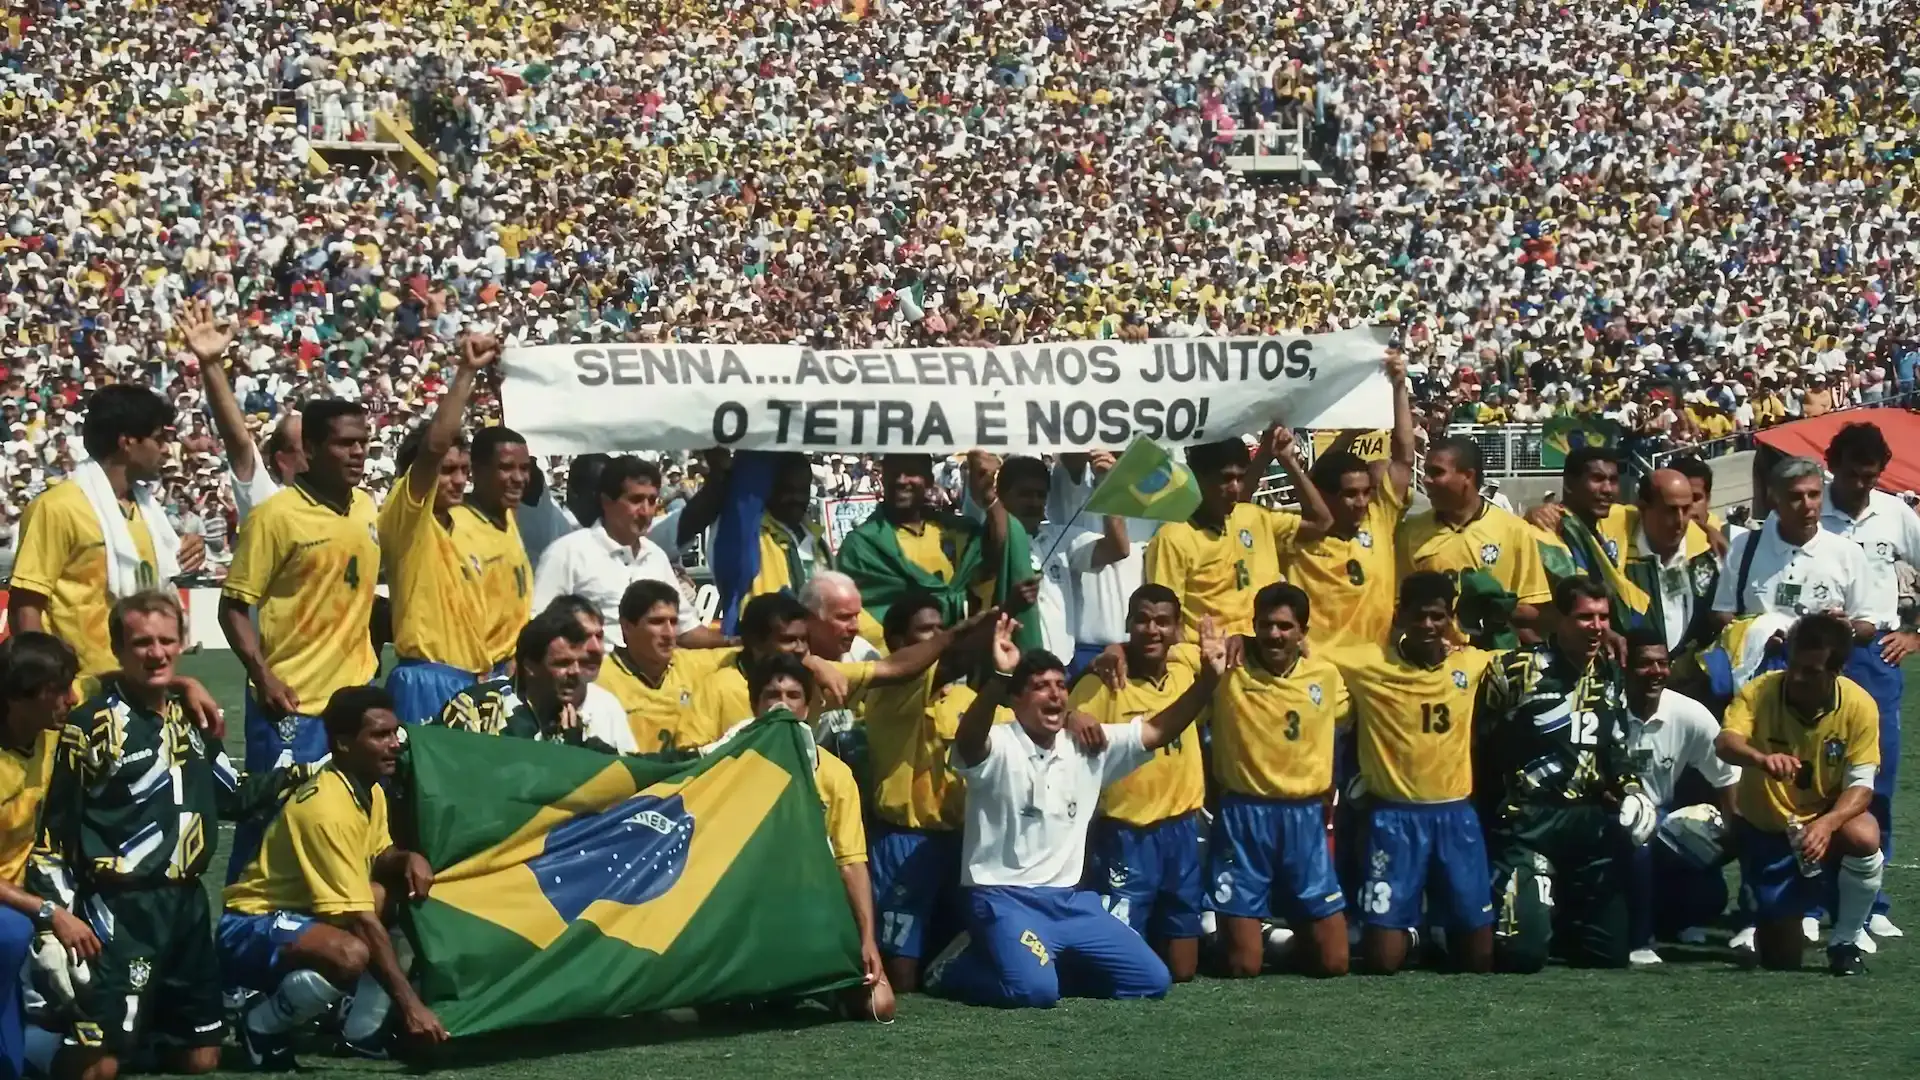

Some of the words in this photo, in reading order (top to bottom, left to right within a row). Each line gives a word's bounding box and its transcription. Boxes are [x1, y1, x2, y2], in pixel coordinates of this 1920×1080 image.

[1140, 339, 1317, 383] JUNTOS,
[712, 401, 748, 444] O
[767, 400, 954, 446] TETRA
[975, 390, 1008, 446] É
[1026, 397, 1210, 446] NOSSO!
[344, 555, 359, 590] 4
[1346, 559, 1364, 586] 9
[1283, 710, 1300, 741] 3
[1420, 703, 1450, 734] 13
[1570, 711, 1599, 745] 12
[169, 765, 183, 805] 1
[1215, 872, 1232, 904] 3
[1364, 881, 1391, 914] 13
[1534, 875, 1554, 906] 12
[882, 911, 914, 948] 17
